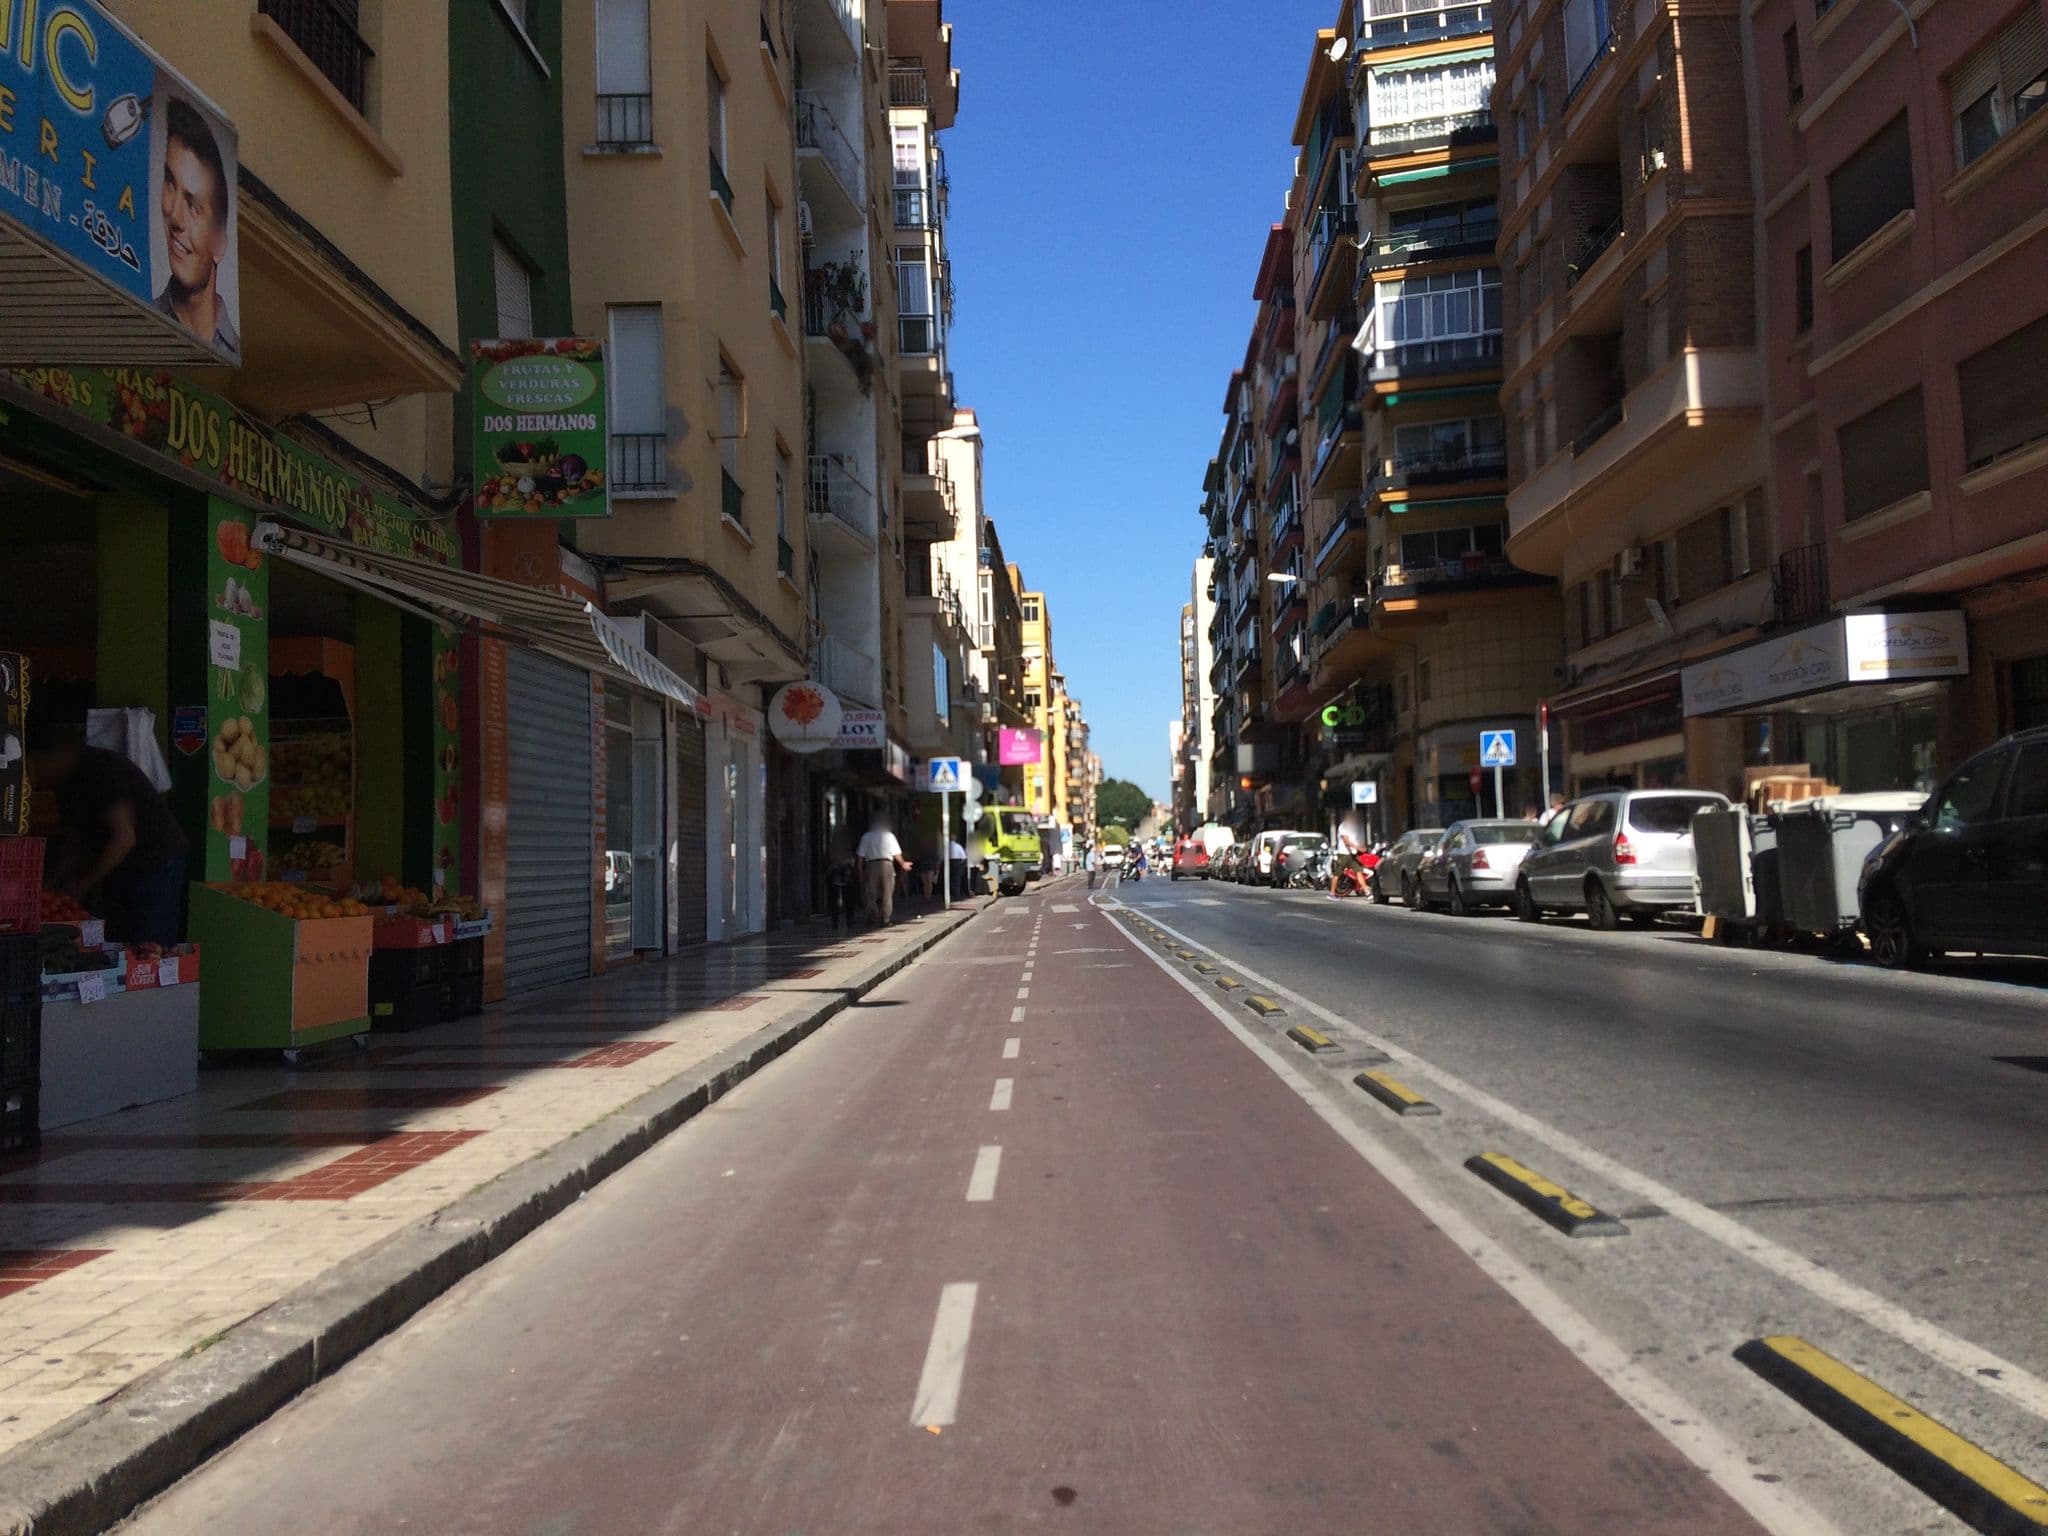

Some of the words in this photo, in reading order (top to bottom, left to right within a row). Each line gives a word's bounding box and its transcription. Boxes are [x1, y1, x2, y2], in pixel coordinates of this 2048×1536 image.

[502, 364, 561, 376] FRUTAS
[565, 363, 577, 374] Y
[498, 379, 582, 390] VERDURAS
[506, 393, 573, 405] FRESCAS
[483, 415, 513, 432] DOS
[516, 413, 597, 432] HERMANOS
[167, 387, 221, 469] DOS
[227, 419, 349, 529] HERMANOS
[412, 524, 457, 561] CALIDAD
[842, 712, 882, 723] OJERIA
[838, 724, 876, 735] LOY
